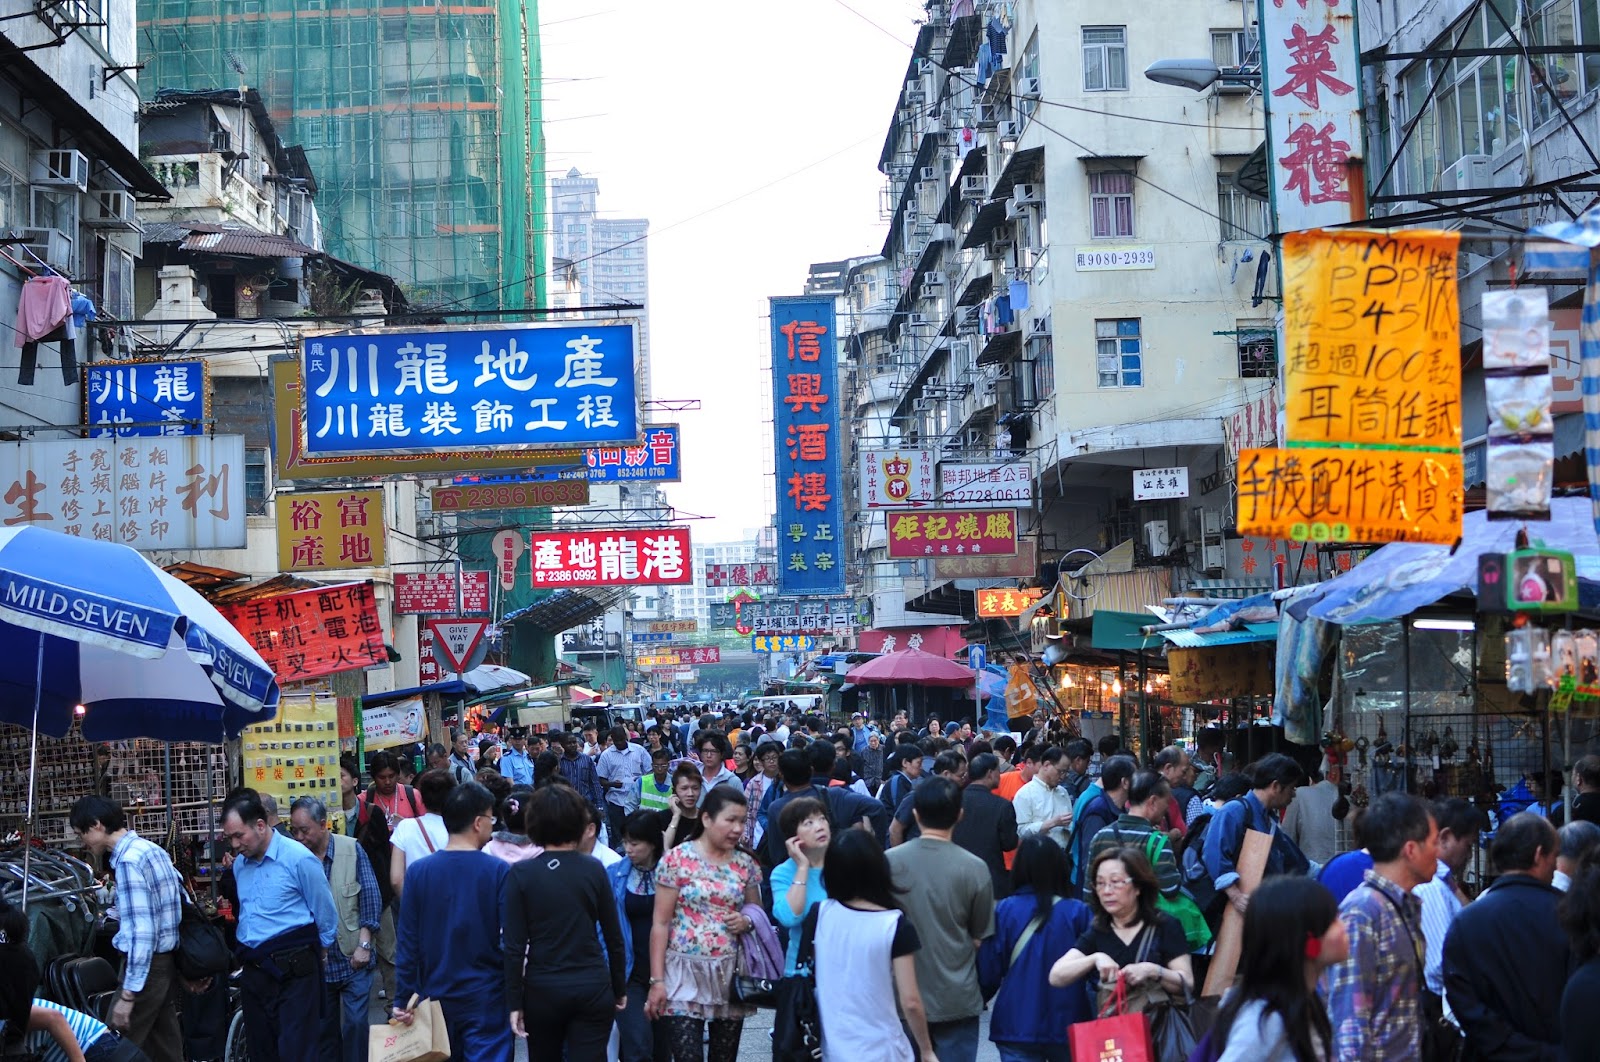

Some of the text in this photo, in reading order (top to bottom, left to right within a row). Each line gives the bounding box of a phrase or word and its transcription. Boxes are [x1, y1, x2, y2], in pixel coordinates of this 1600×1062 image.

[96, 366, 195, 404] 川龍
[316, 335, 618, 397] 川龍地產
[316, 395, 619, 438] 川龍裝飾工程
[780, 320, 832, 512] 信興酒樓
[1298, 384, 1457, 440] 耳筒任試
[90, 449, 112, 542] 寬頻上網
[120, 448, 142, 542] 電腦維修
[148, 447, 169, 541] 相片沖印
[467, 483, 585, 508] 2386 1633
[891, 481, 904, 495] 押
[943, 467, 1030, 485] 聯邦地產公司
[958, 488, 1031, 503] 2728 0613
[813, 523, 835, 571] 正宗
[892, 513, 1013, 541] 鉅記燒臘
[572, 569, 597, 581] 0992
[6, 581, 150, 638] MILD SEVEN
[453, 643, 465, 654] 讓
[256, 765, 325, 781] 原裝配件
